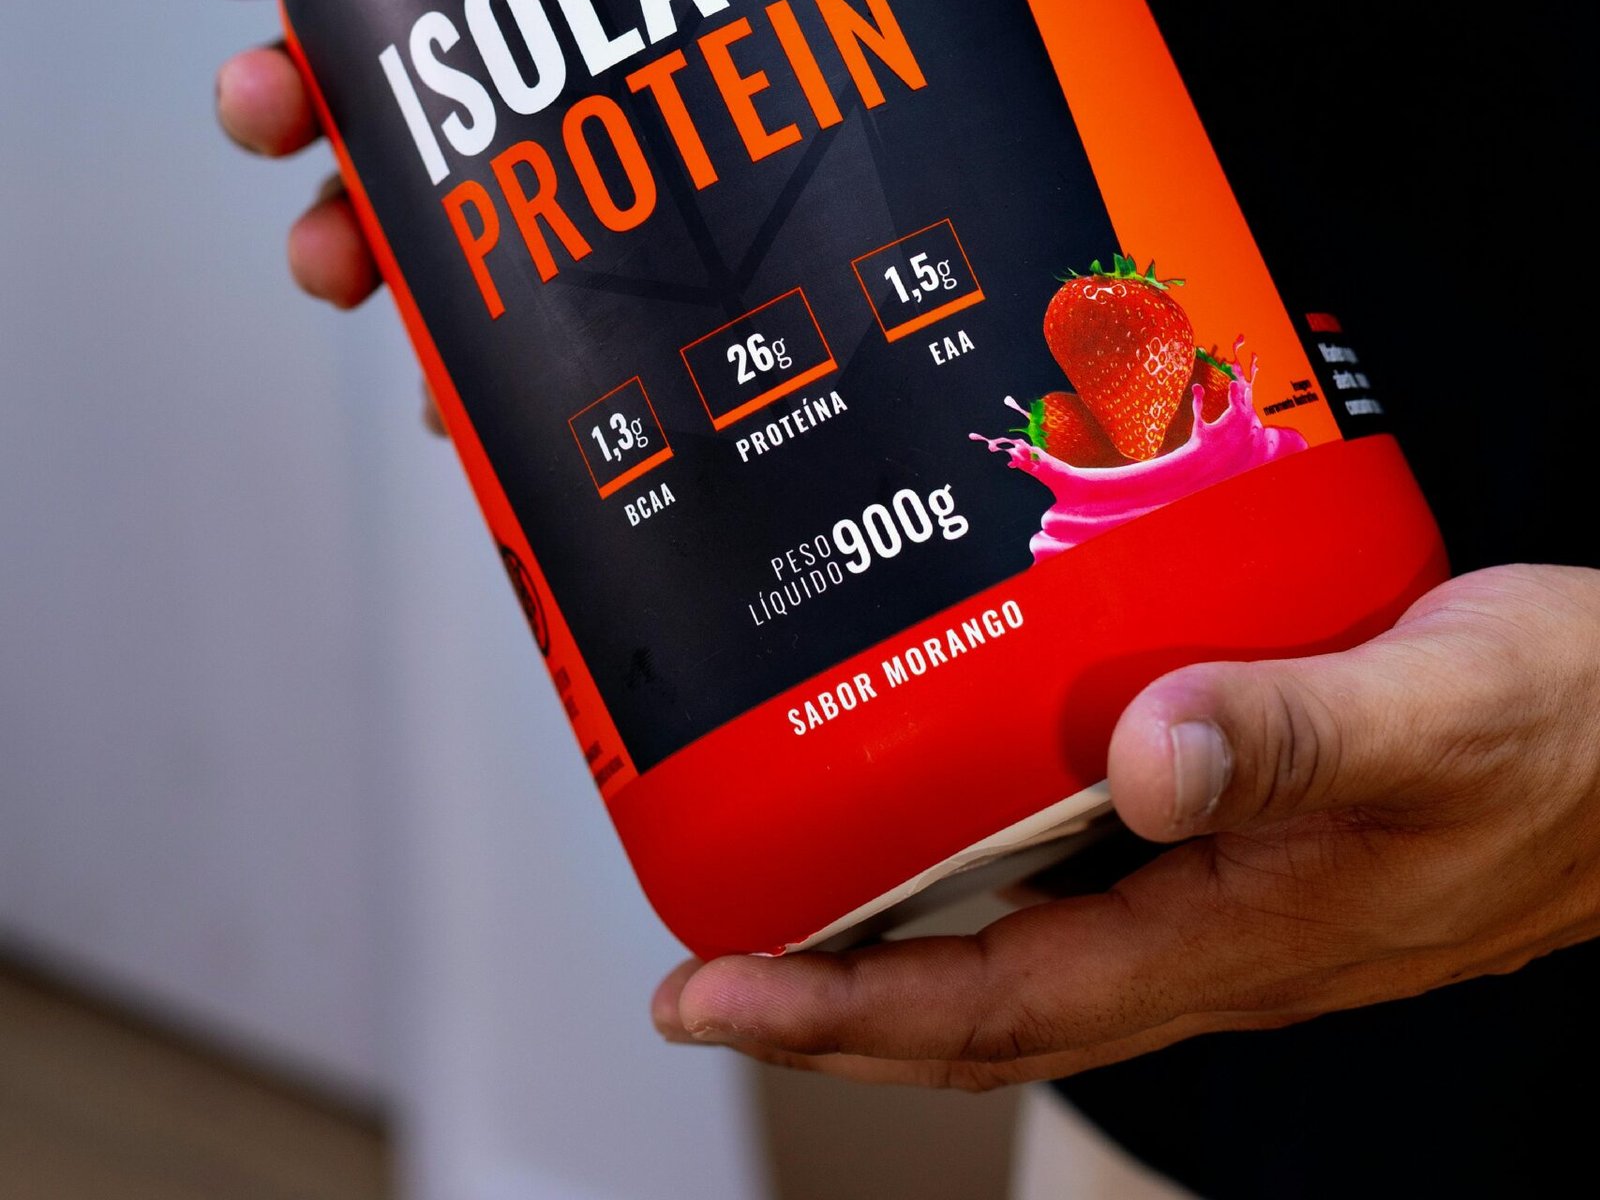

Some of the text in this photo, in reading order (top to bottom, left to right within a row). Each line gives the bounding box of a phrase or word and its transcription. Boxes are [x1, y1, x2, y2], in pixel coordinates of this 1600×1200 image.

[884, 253, 957, 304] 1,5g
[727, 333, 793, 384] 26g
[929, 330, 975, 366] EAA
[591, 412, 649, 462] 1,3g
[735, 390, 848, 463] PROTEÍNA
[624, 483, 676, 527] BCAA
[832, 484, 969, 573] 900g
[771, 534, 831, 581] PESO
[748, 560, 844, 626] LÍQUIDO
[787, 600, 1025, 736] SABOR MORANGO
